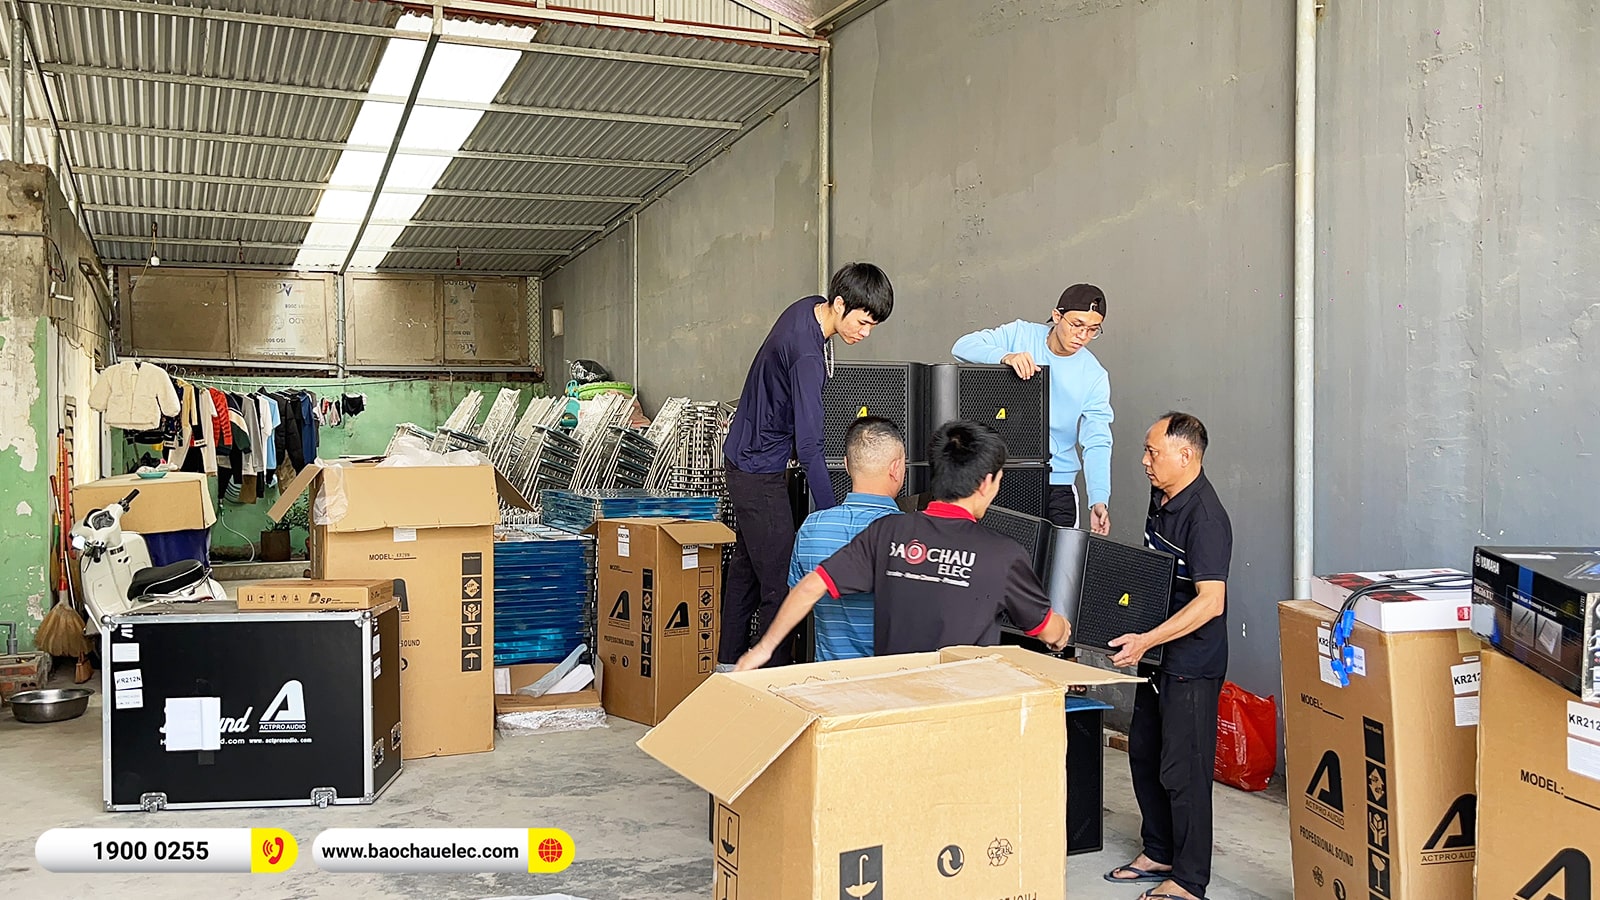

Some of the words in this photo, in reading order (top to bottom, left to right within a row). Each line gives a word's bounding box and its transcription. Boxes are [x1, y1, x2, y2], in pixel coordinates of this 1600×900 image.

[937, 563, 972, 579] ELEC
[1480, 555, 1500, 575] YAMAHA
[1520, 769, 1565, 796] MODEL:
[1300, 825, 1335, 857] PROFESSIONAL
[1334, 846, 1354, 867] SOUND
[1421, 852, 1458, 863] ACTPRO
